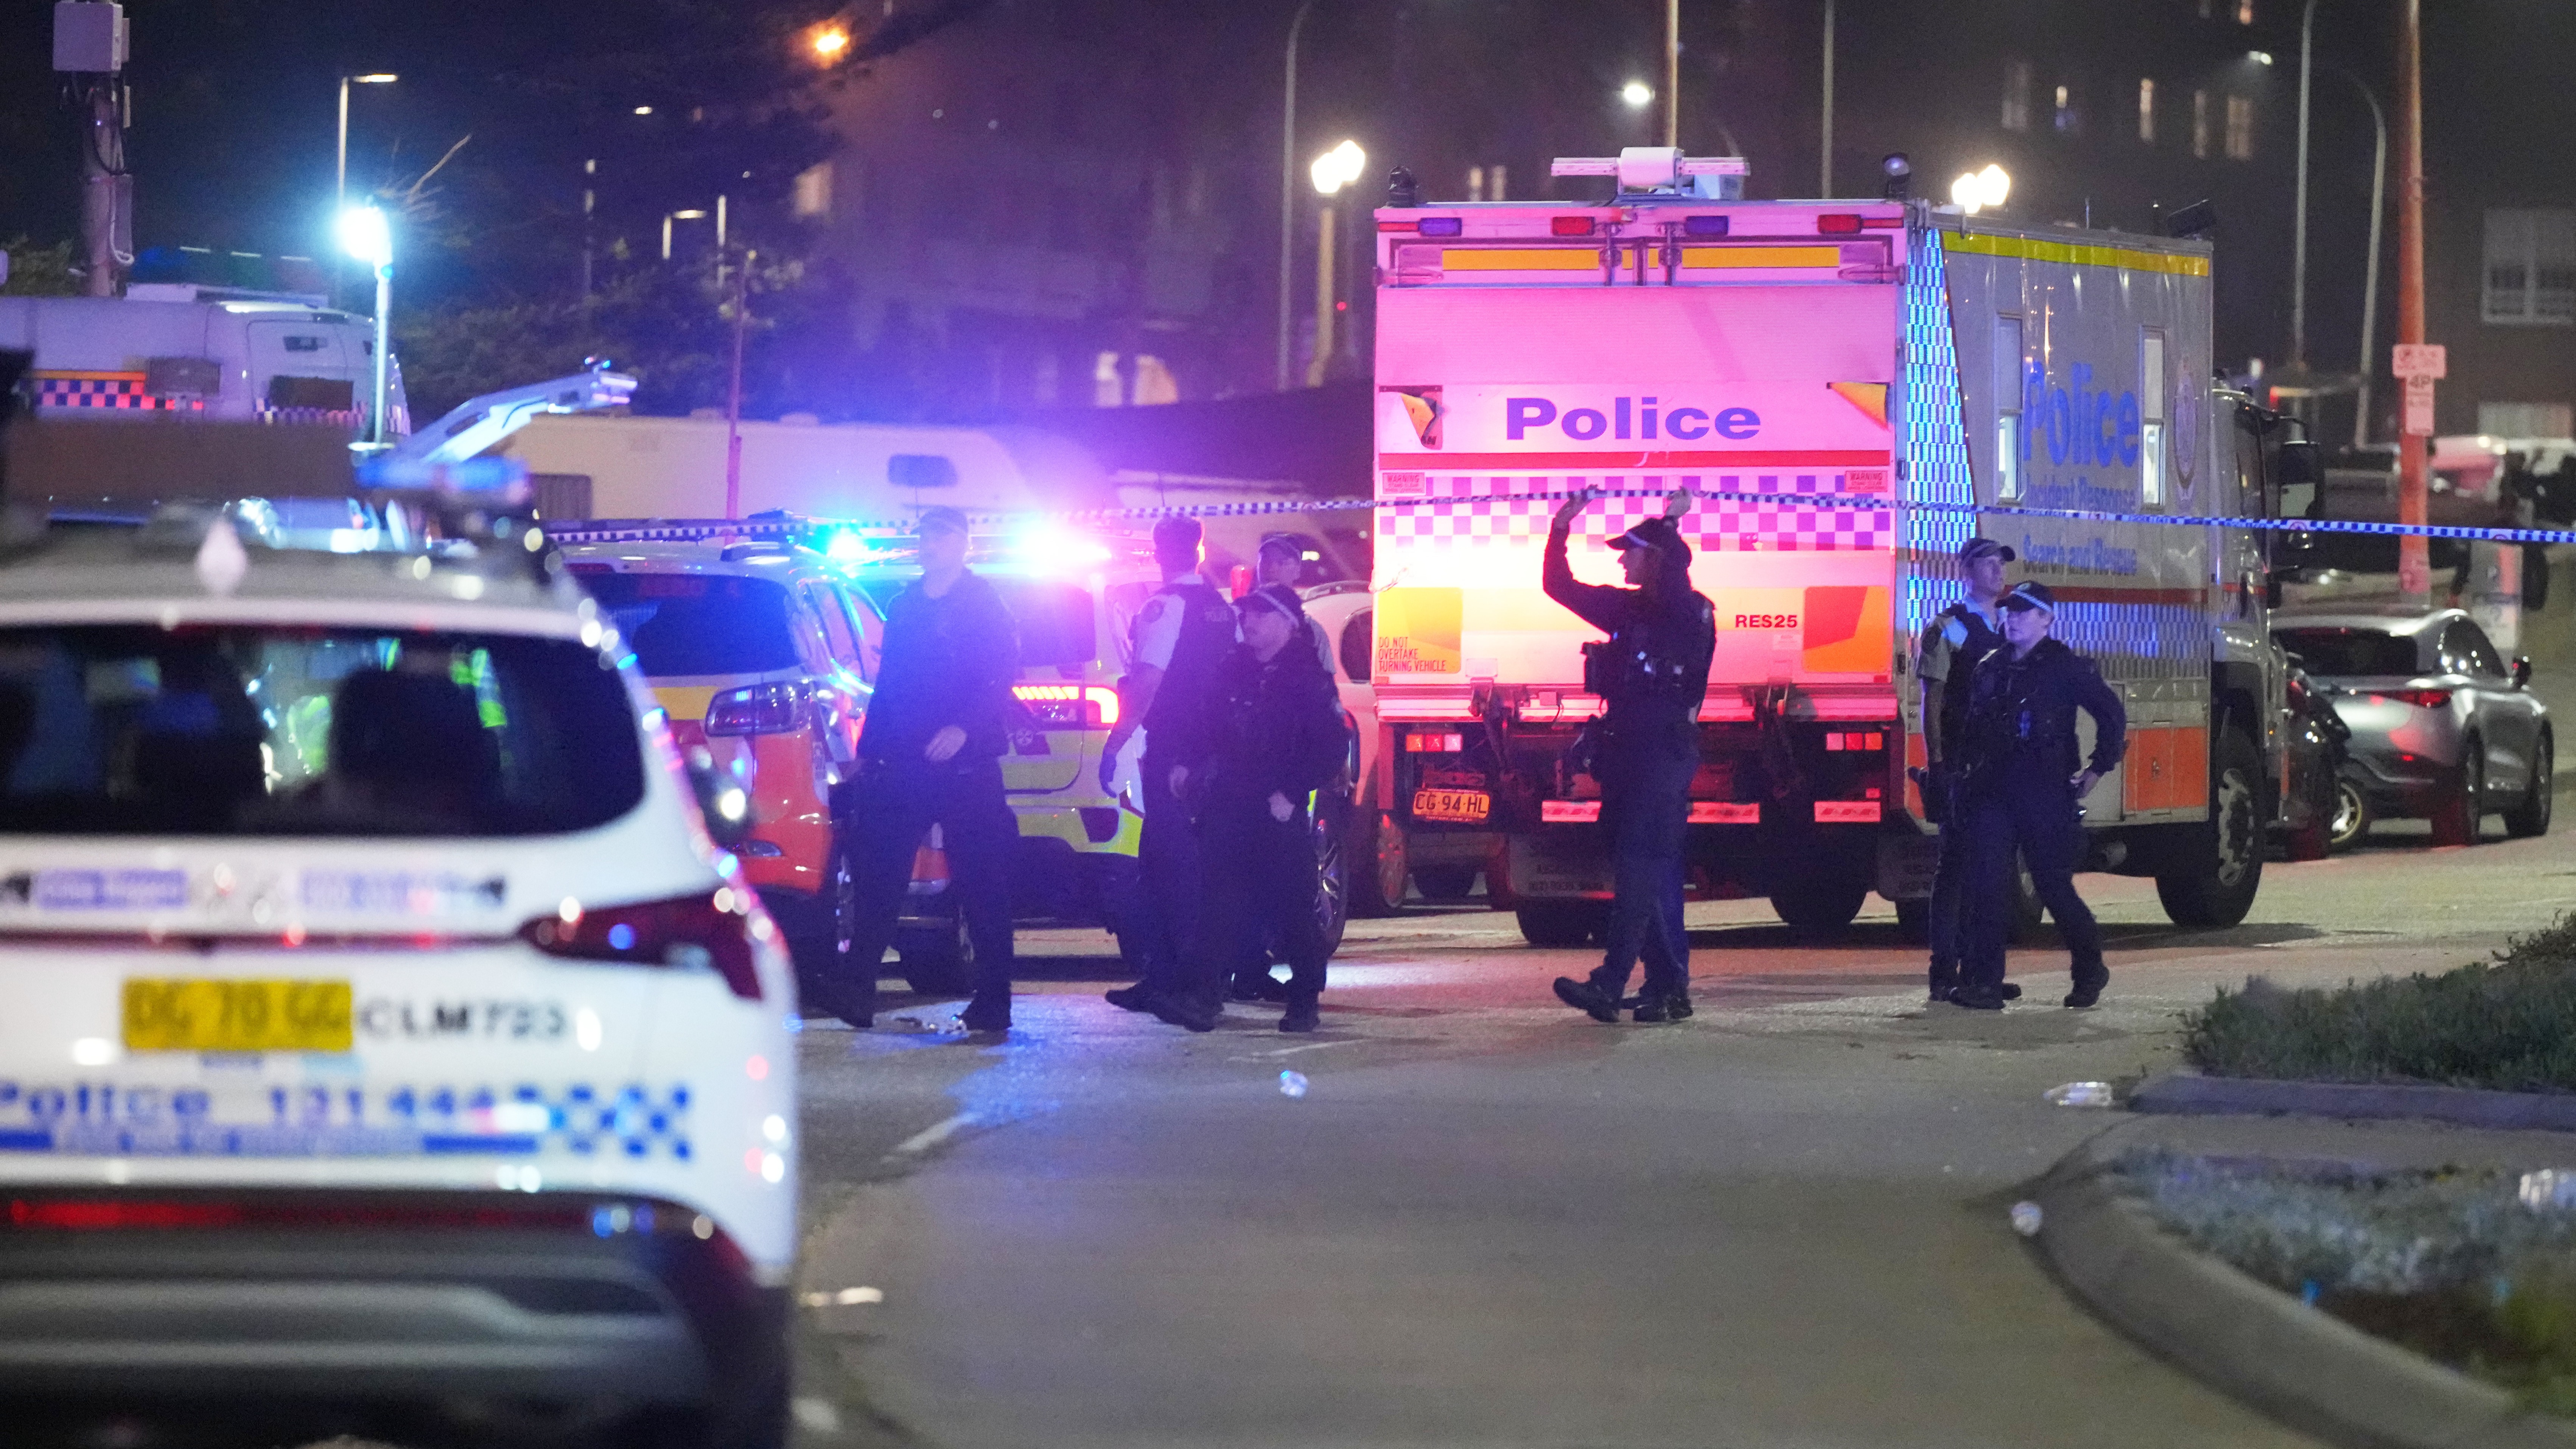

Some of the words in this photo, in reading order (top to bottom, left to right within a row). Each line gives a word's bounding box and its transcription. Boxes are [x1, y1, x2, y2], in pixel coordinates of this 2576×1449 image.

[1507, 397, 1761, 440] Police
[2022, 361, 2139, 468] Police
[1735, 615, 1798, 628] RES25
[1379, 637, 1389, 647] DO
[1393, 637, 1408, 647] NOT
[1378, 648, 1418, 660] OVERTAKE
[1378, 660, 1412, 672] TURNING
[1415, 660, 1447, 672] VEHICLE
